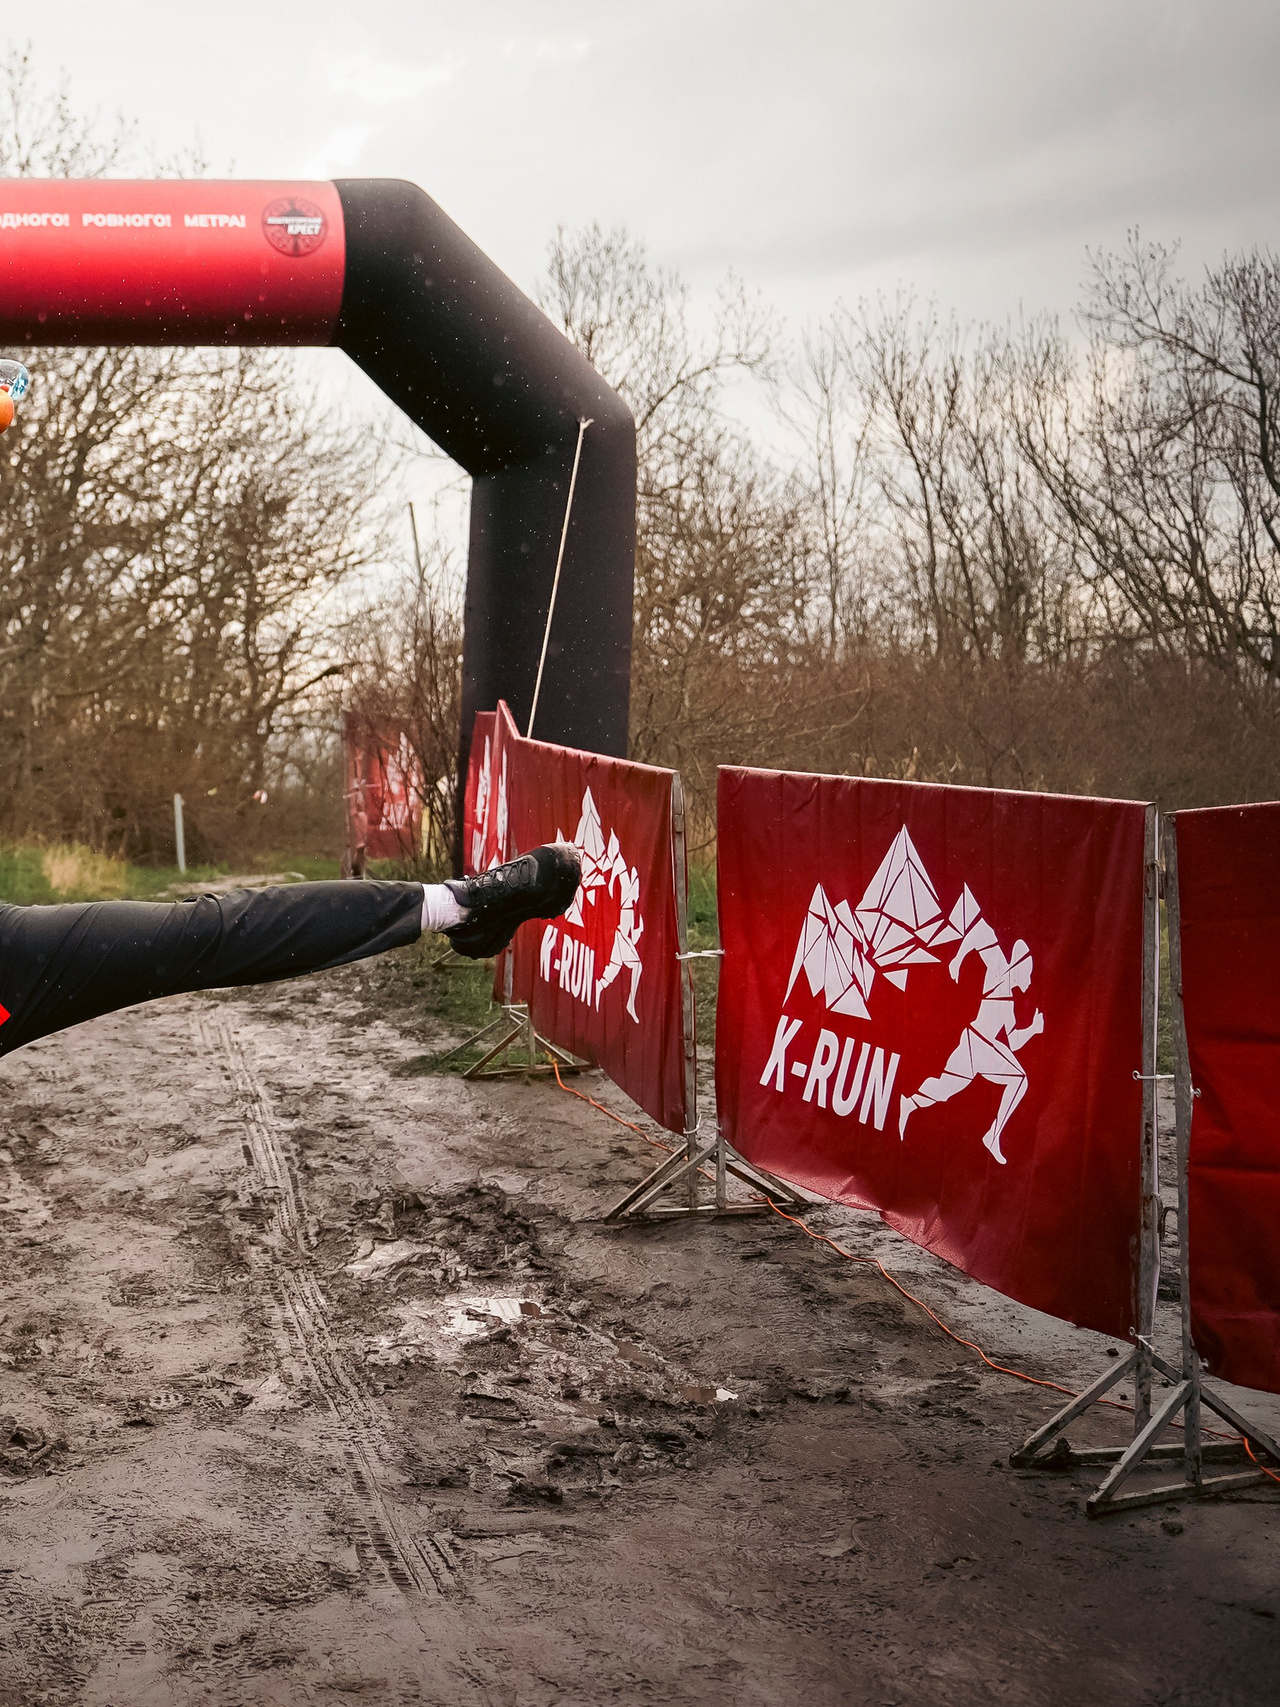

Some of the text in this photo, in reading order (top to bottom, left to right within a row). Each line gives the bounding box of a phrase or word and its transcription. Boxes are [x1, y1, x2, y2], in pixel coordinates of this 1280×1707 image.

[81, 213, 172, 228] РОВНОГО!
[184, 214, 246, 228] МЕТРА!
[539, 924, 596, 1007] K-RUN
[758, 1014, 902, 1132] K-RUN
